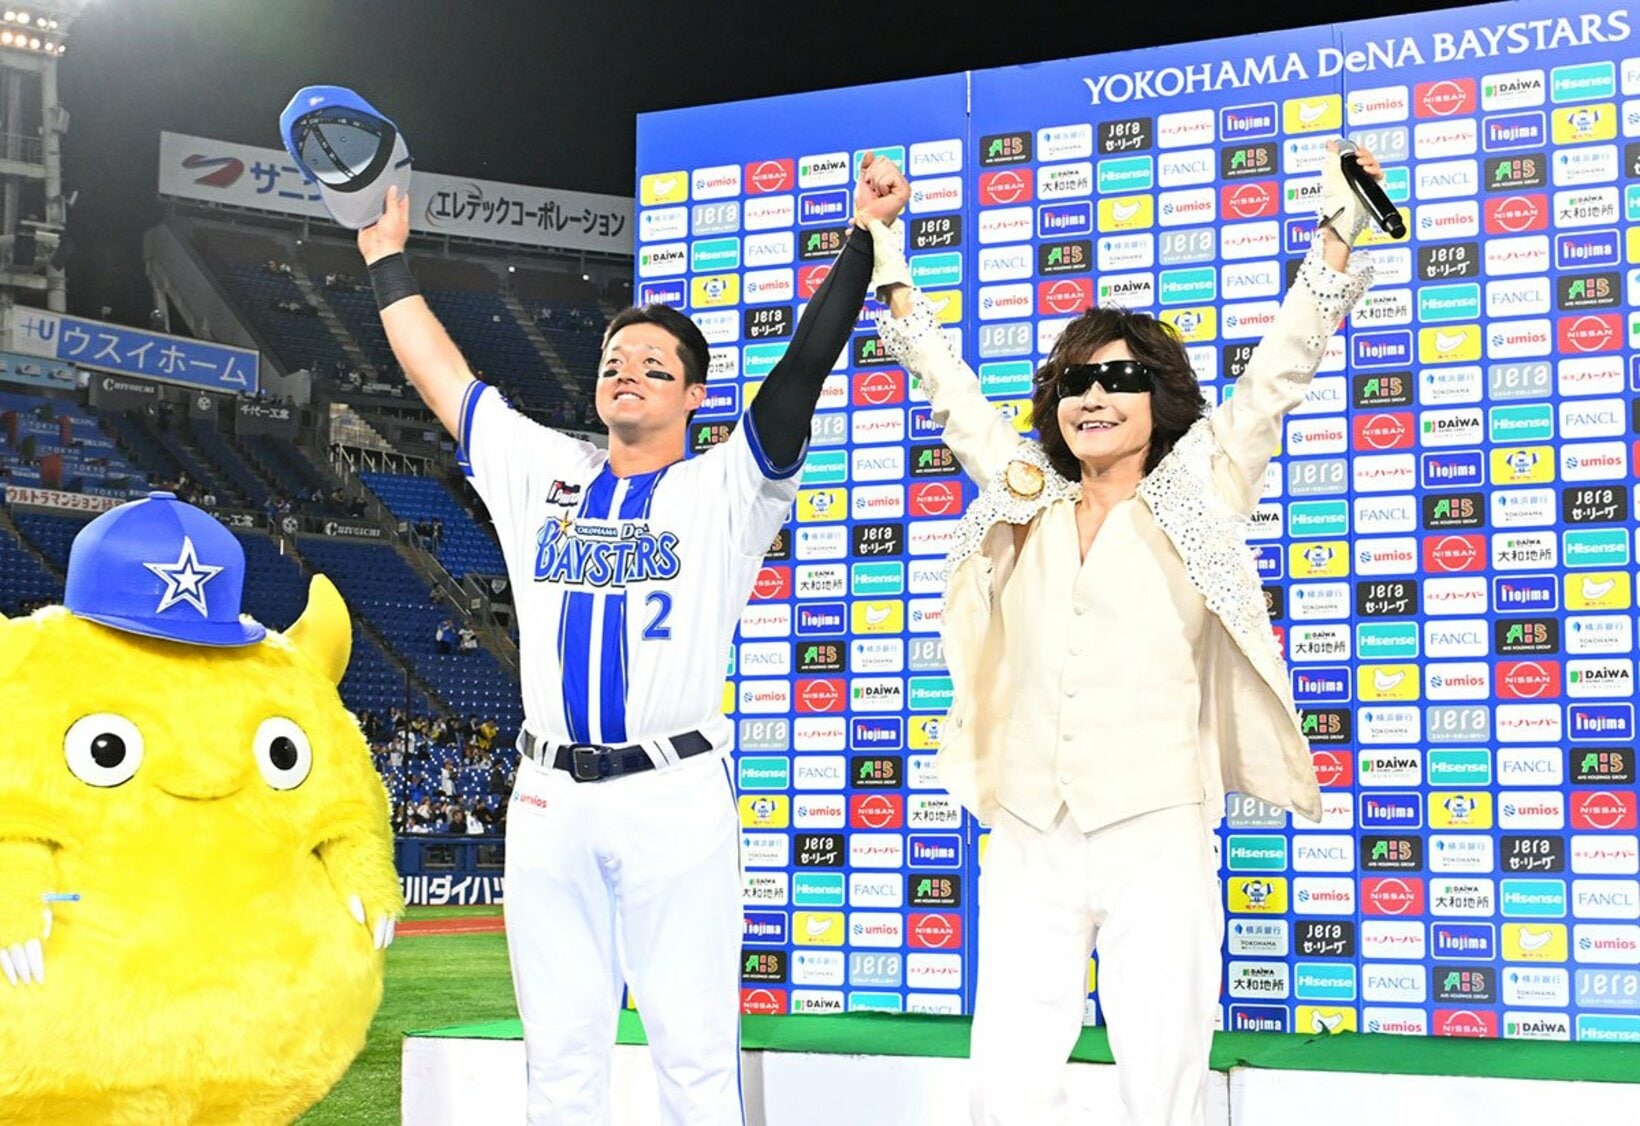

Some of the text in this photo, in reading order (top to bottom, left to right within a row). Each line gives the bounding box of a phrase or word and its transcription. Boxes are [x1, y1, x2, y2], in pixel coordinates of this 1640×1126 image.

[1083, 9, 1631, 105] YOKOHAMA DeNA BAYSTARS
[1423, 93, 1466, 103] NISSAN
[1366, 98, 1404, 112] umios
[1421, 172, 1470, 187] FANCL
[925, 188, 958, 199] umios
[436, 191, 625, 237] エレテックコーポレーション
[1494, 209, 1538, 219] NISSAN
[1436, 215, 1473, 227] umios
[1227, 273, 1273, 287] FANCL
[1046, 291, 1084, 303] NISSAN
[1492, 290, 1542, 304] FANCL
[1421, 298, 1477, 309] Hisense
[1567, 329, 1613, 338] NISSAN
[1508, 334, 1546, 345] umios
[62, 326, 248, 386] ウスイホーム
[981, 371, 1031, 385] Hisense
[860, 384, 897, 392] NISSAN
[1493, 419, 1550, 429] Hisense
[1566, 412, 1618, 426] FANCL
[1306, 431, 1343, 442] umios
[1362, 427, 1406, 436] NISSAN
[857, 458, 898, 470] FANCL
[1581, 456, 1622, 468] umios
[869, 497, 901, 508] umios
[916, 495, 954, 503] NISSAN
[1292, 514, 1344, 524] Hisense
[1360, 508, 1409, 521] FANCL
[1432, 549, 1477, 558] NISSAN
[1567, 544, 1626, 553] Hisense
[1375, 552, 1413, 562] umios
[854, 574, 901, 584] Hisense
[642, 590, 673, 641] 2
[1360, 636, 1415, 645] Hisense
[1430, 632, 1481, 644] FANCL
[1445, 677, 1485, 687] umios
[1505, 676, 1551, 684] NISSAN
[755, 693, 786, 701] umios
[1431, 762, 1488, 772] Hisense
[1503, 760, 1555, 772] FANCL
[741, 769, 786, 778] Hisense
[798, 767, 840, 778] FANCL
[810, 808, 842, 817] umios
[1519, 806, 1559, 816] umios
[1580, 806, 1627, 814] NISSAN
[1231, 848, 1283, 858] Hisense
[1298, 847, 1347, 859] FANCL
[1313, 891, 1350, 902] umios
[1370, 892, 1415, 900] NISSAN
[1504, 893, 1563, 903] Hisense
[1578, 893, 1633, 906] FANCL
[866, 925, 899, 936] umios
[1594, 939, 1639, 951] umios
[1298, 976, 1352, 987] Hisense
[1368, 976, 1419, 990] FANCL
[743, 1001, 779, 1010] NISSAN
[1382, 1019, 1422, 1033] umios
[1442, 1022, 1488, 1034] NISSAN
